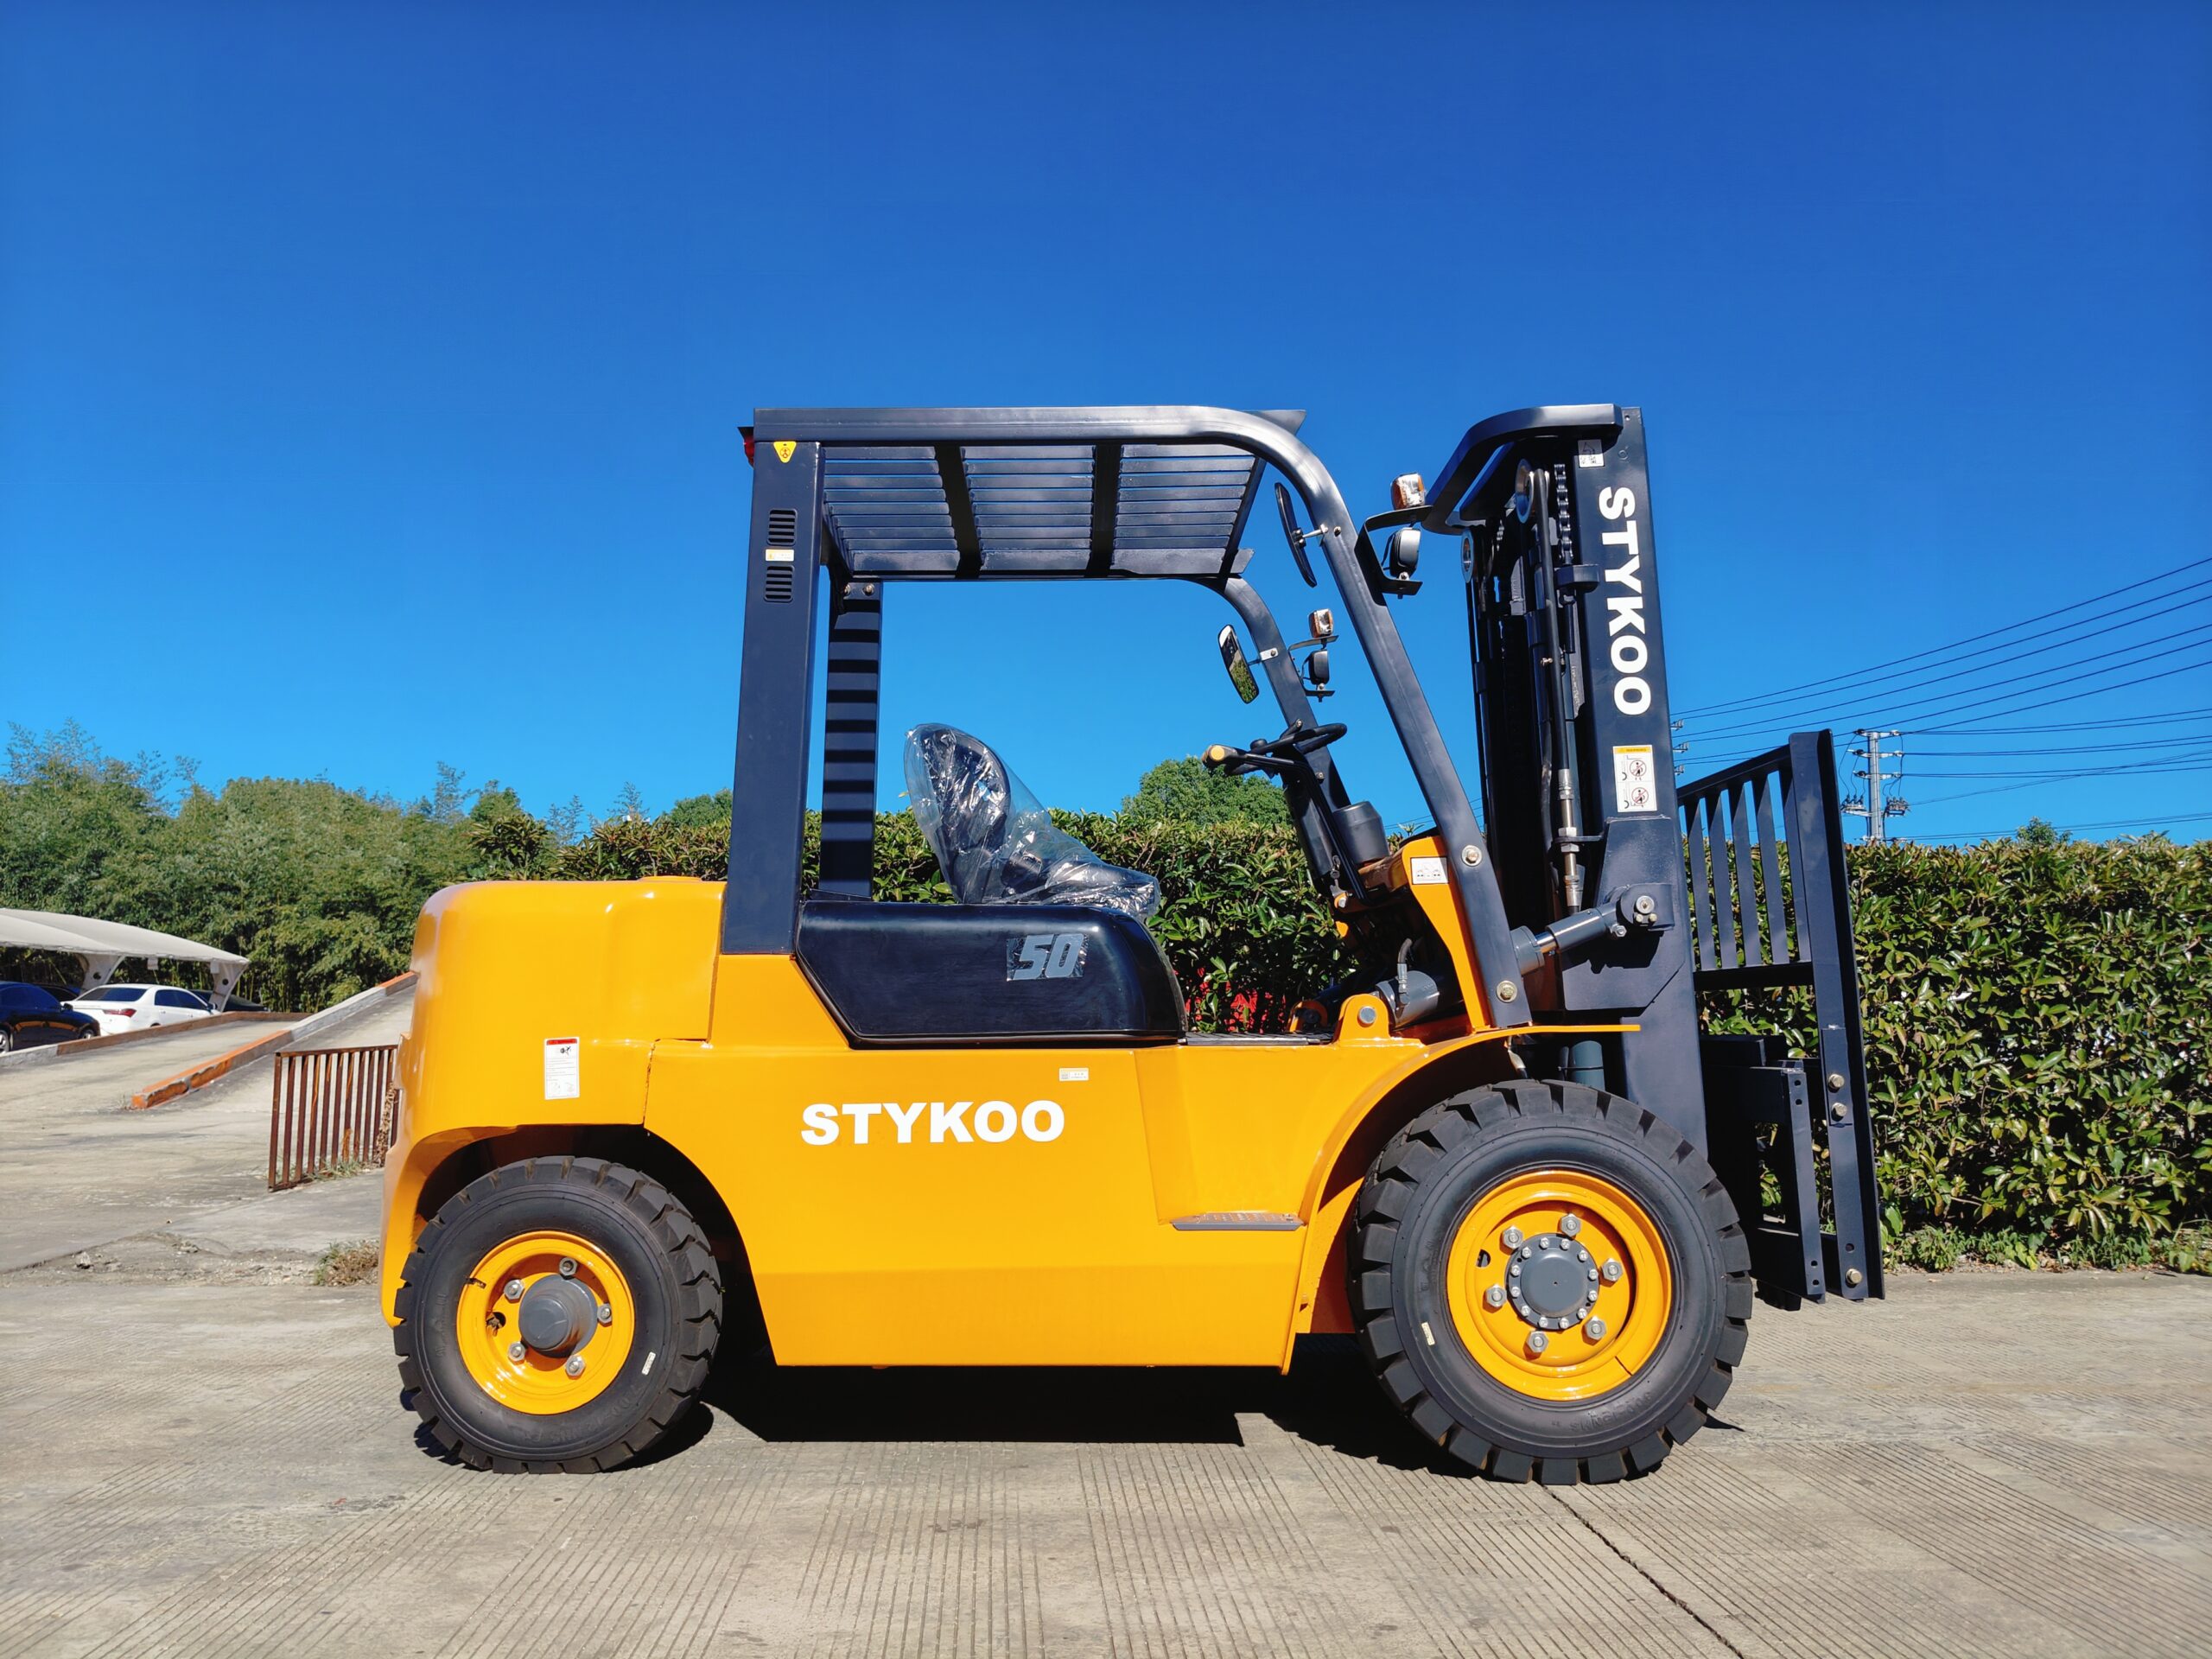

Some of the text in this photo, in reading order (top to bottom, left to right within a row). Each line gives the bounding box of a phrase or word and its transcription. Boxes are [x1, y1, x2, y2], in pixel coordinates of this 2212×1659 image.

[1599, 486, 1651, 715] STYKOO
[1013, 933, 1084, 981] 50
[801, 1100, 1065, 1145] STYKOO
